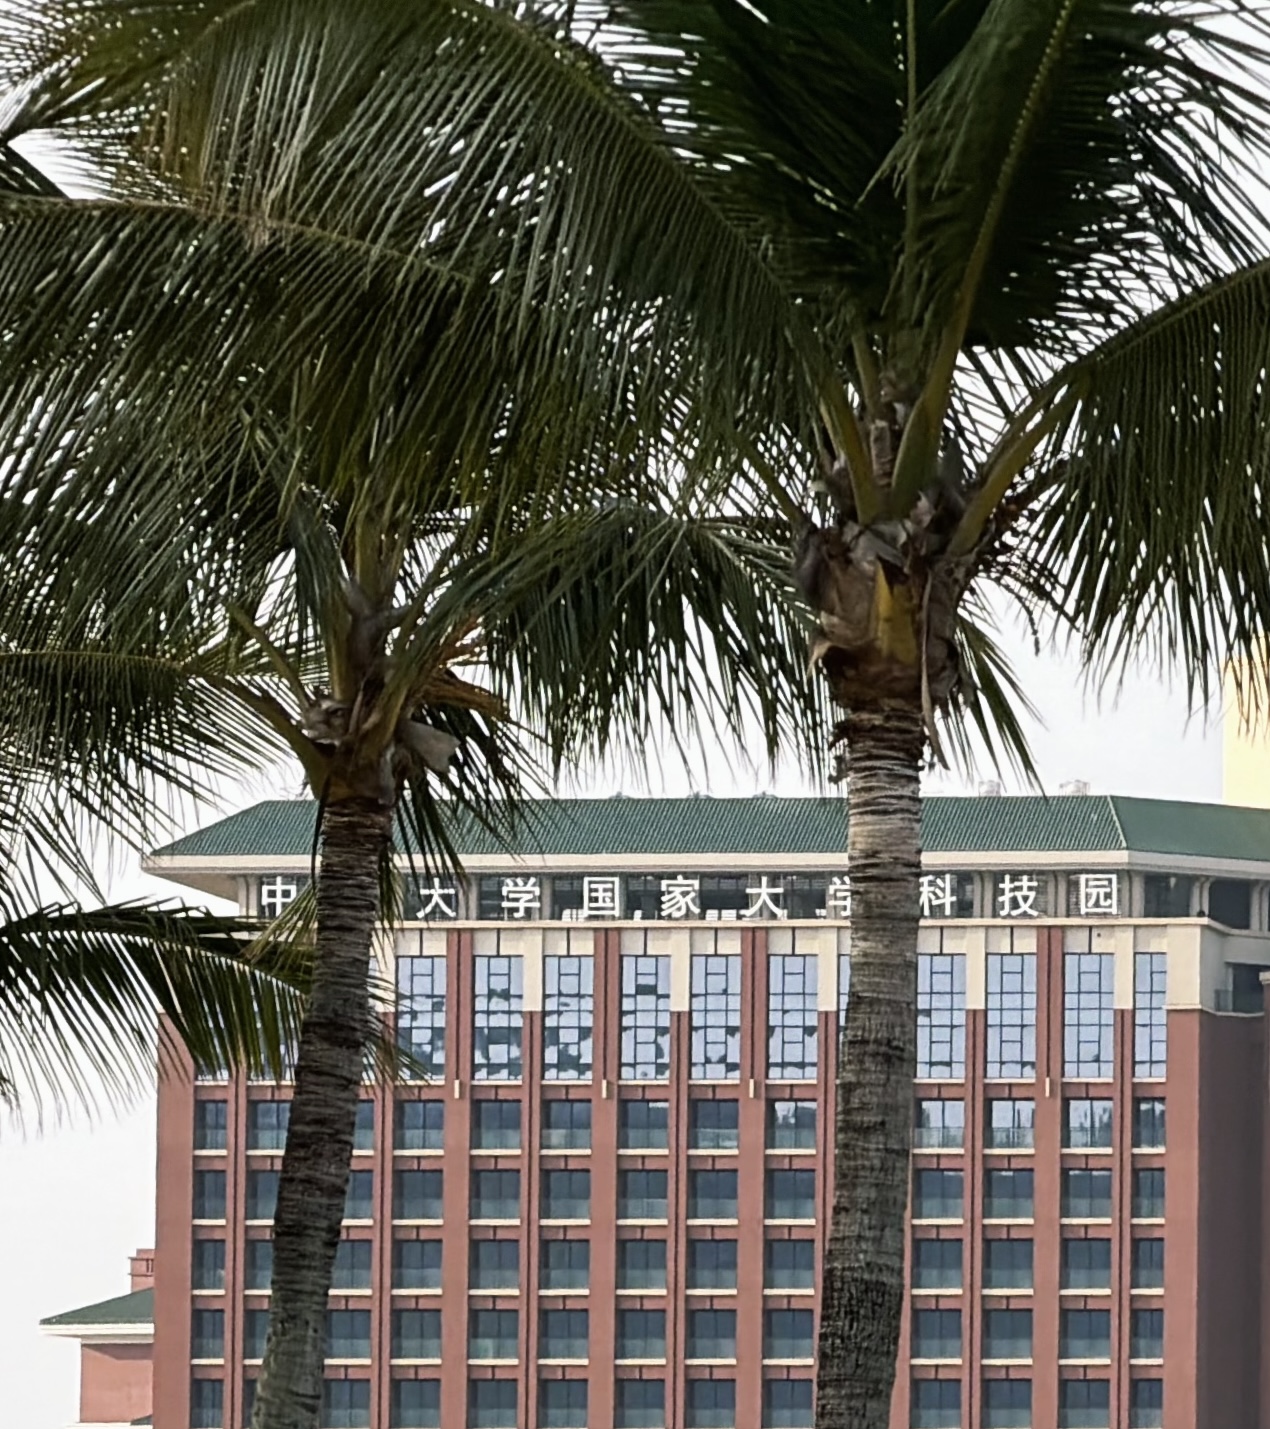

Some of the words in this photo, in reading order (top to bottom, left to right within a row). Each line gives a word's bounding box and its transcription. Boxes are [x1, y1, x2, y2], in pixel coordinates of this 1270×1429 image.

[261, 873, 1118, 918] 中大学国家大学科技园
